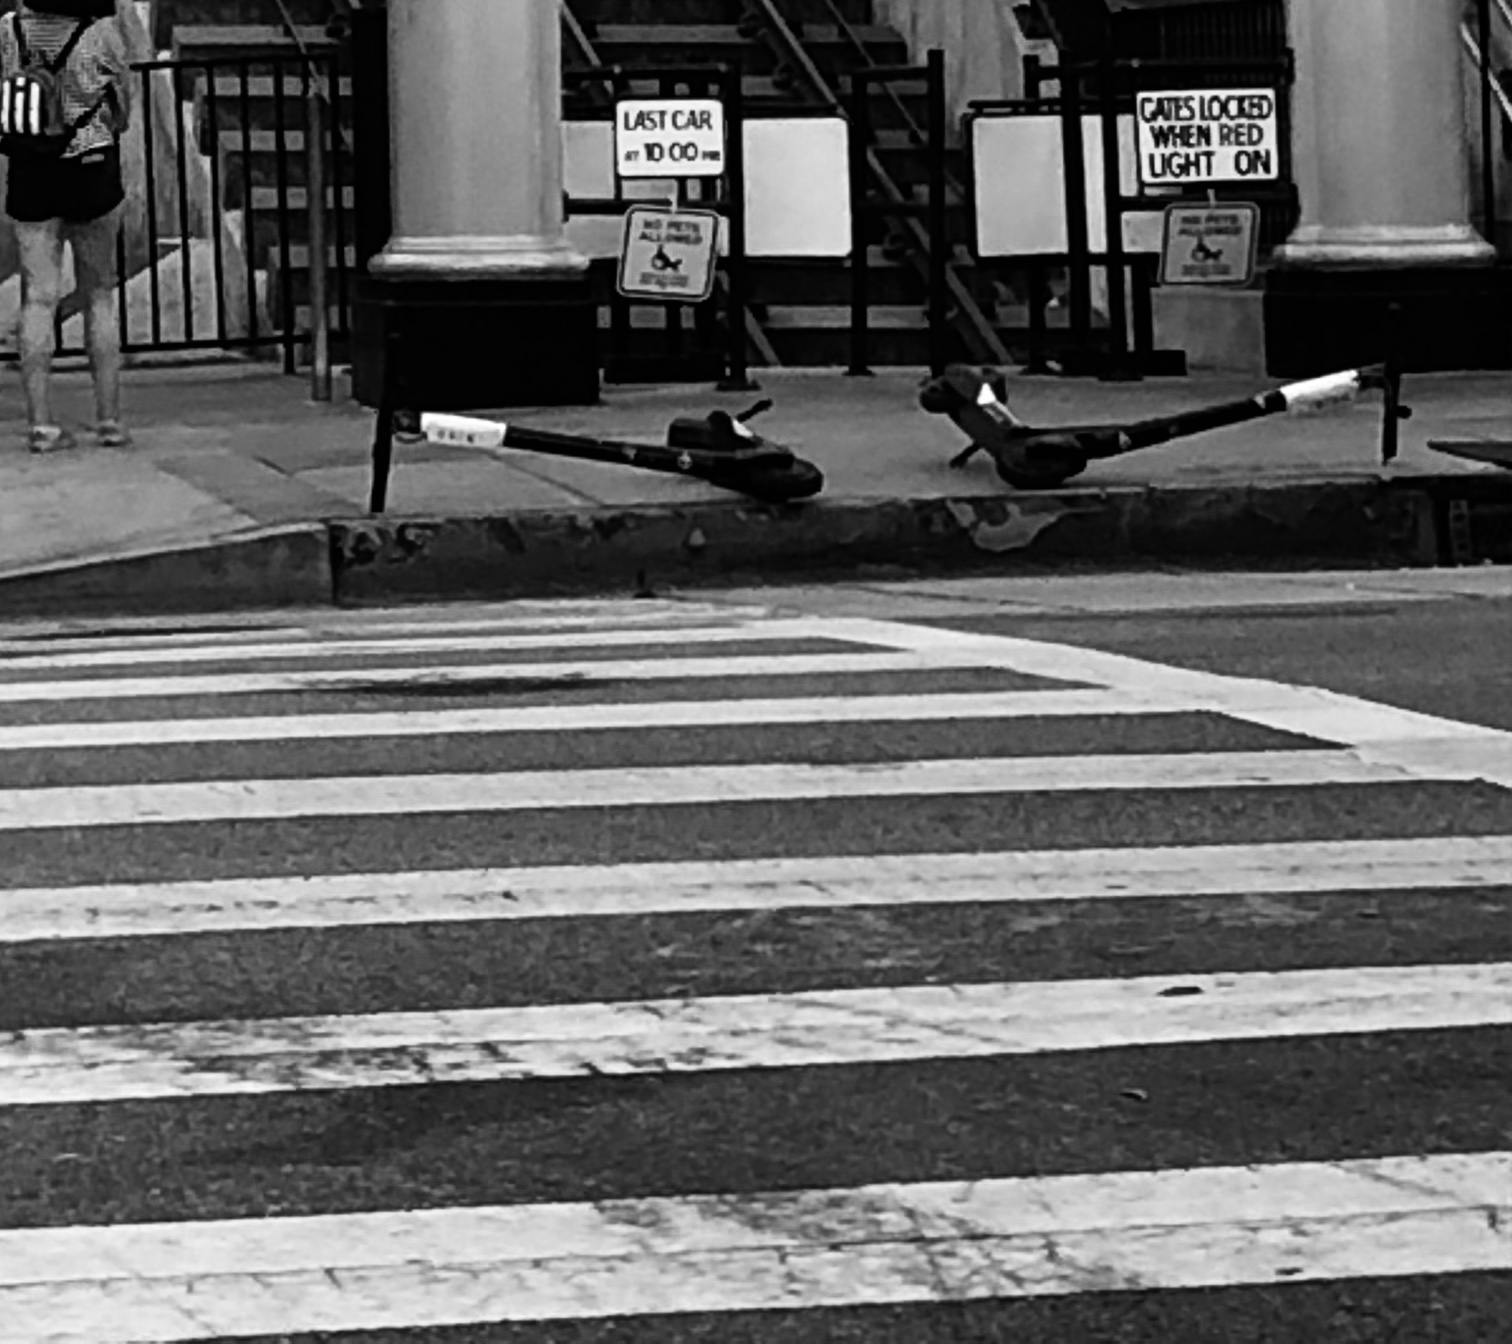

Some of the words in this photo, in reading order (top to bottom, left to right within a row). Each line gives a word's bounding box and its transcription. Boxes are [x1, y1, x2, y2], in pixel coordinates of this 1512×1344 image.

[624, 109, 667, 131] LAST
[671, 109, 713, 131] CAR
[1139, 96, 1195, 123] GATES
[1199, 95, 1273, 121] LOCKED
[1149, 124, 1211, 149] WHEN
[1218, 122, 1264, 146] RED
[1149, 151, 1215, 178] LIGHT
[1234, 149, 1271, 176] ON
